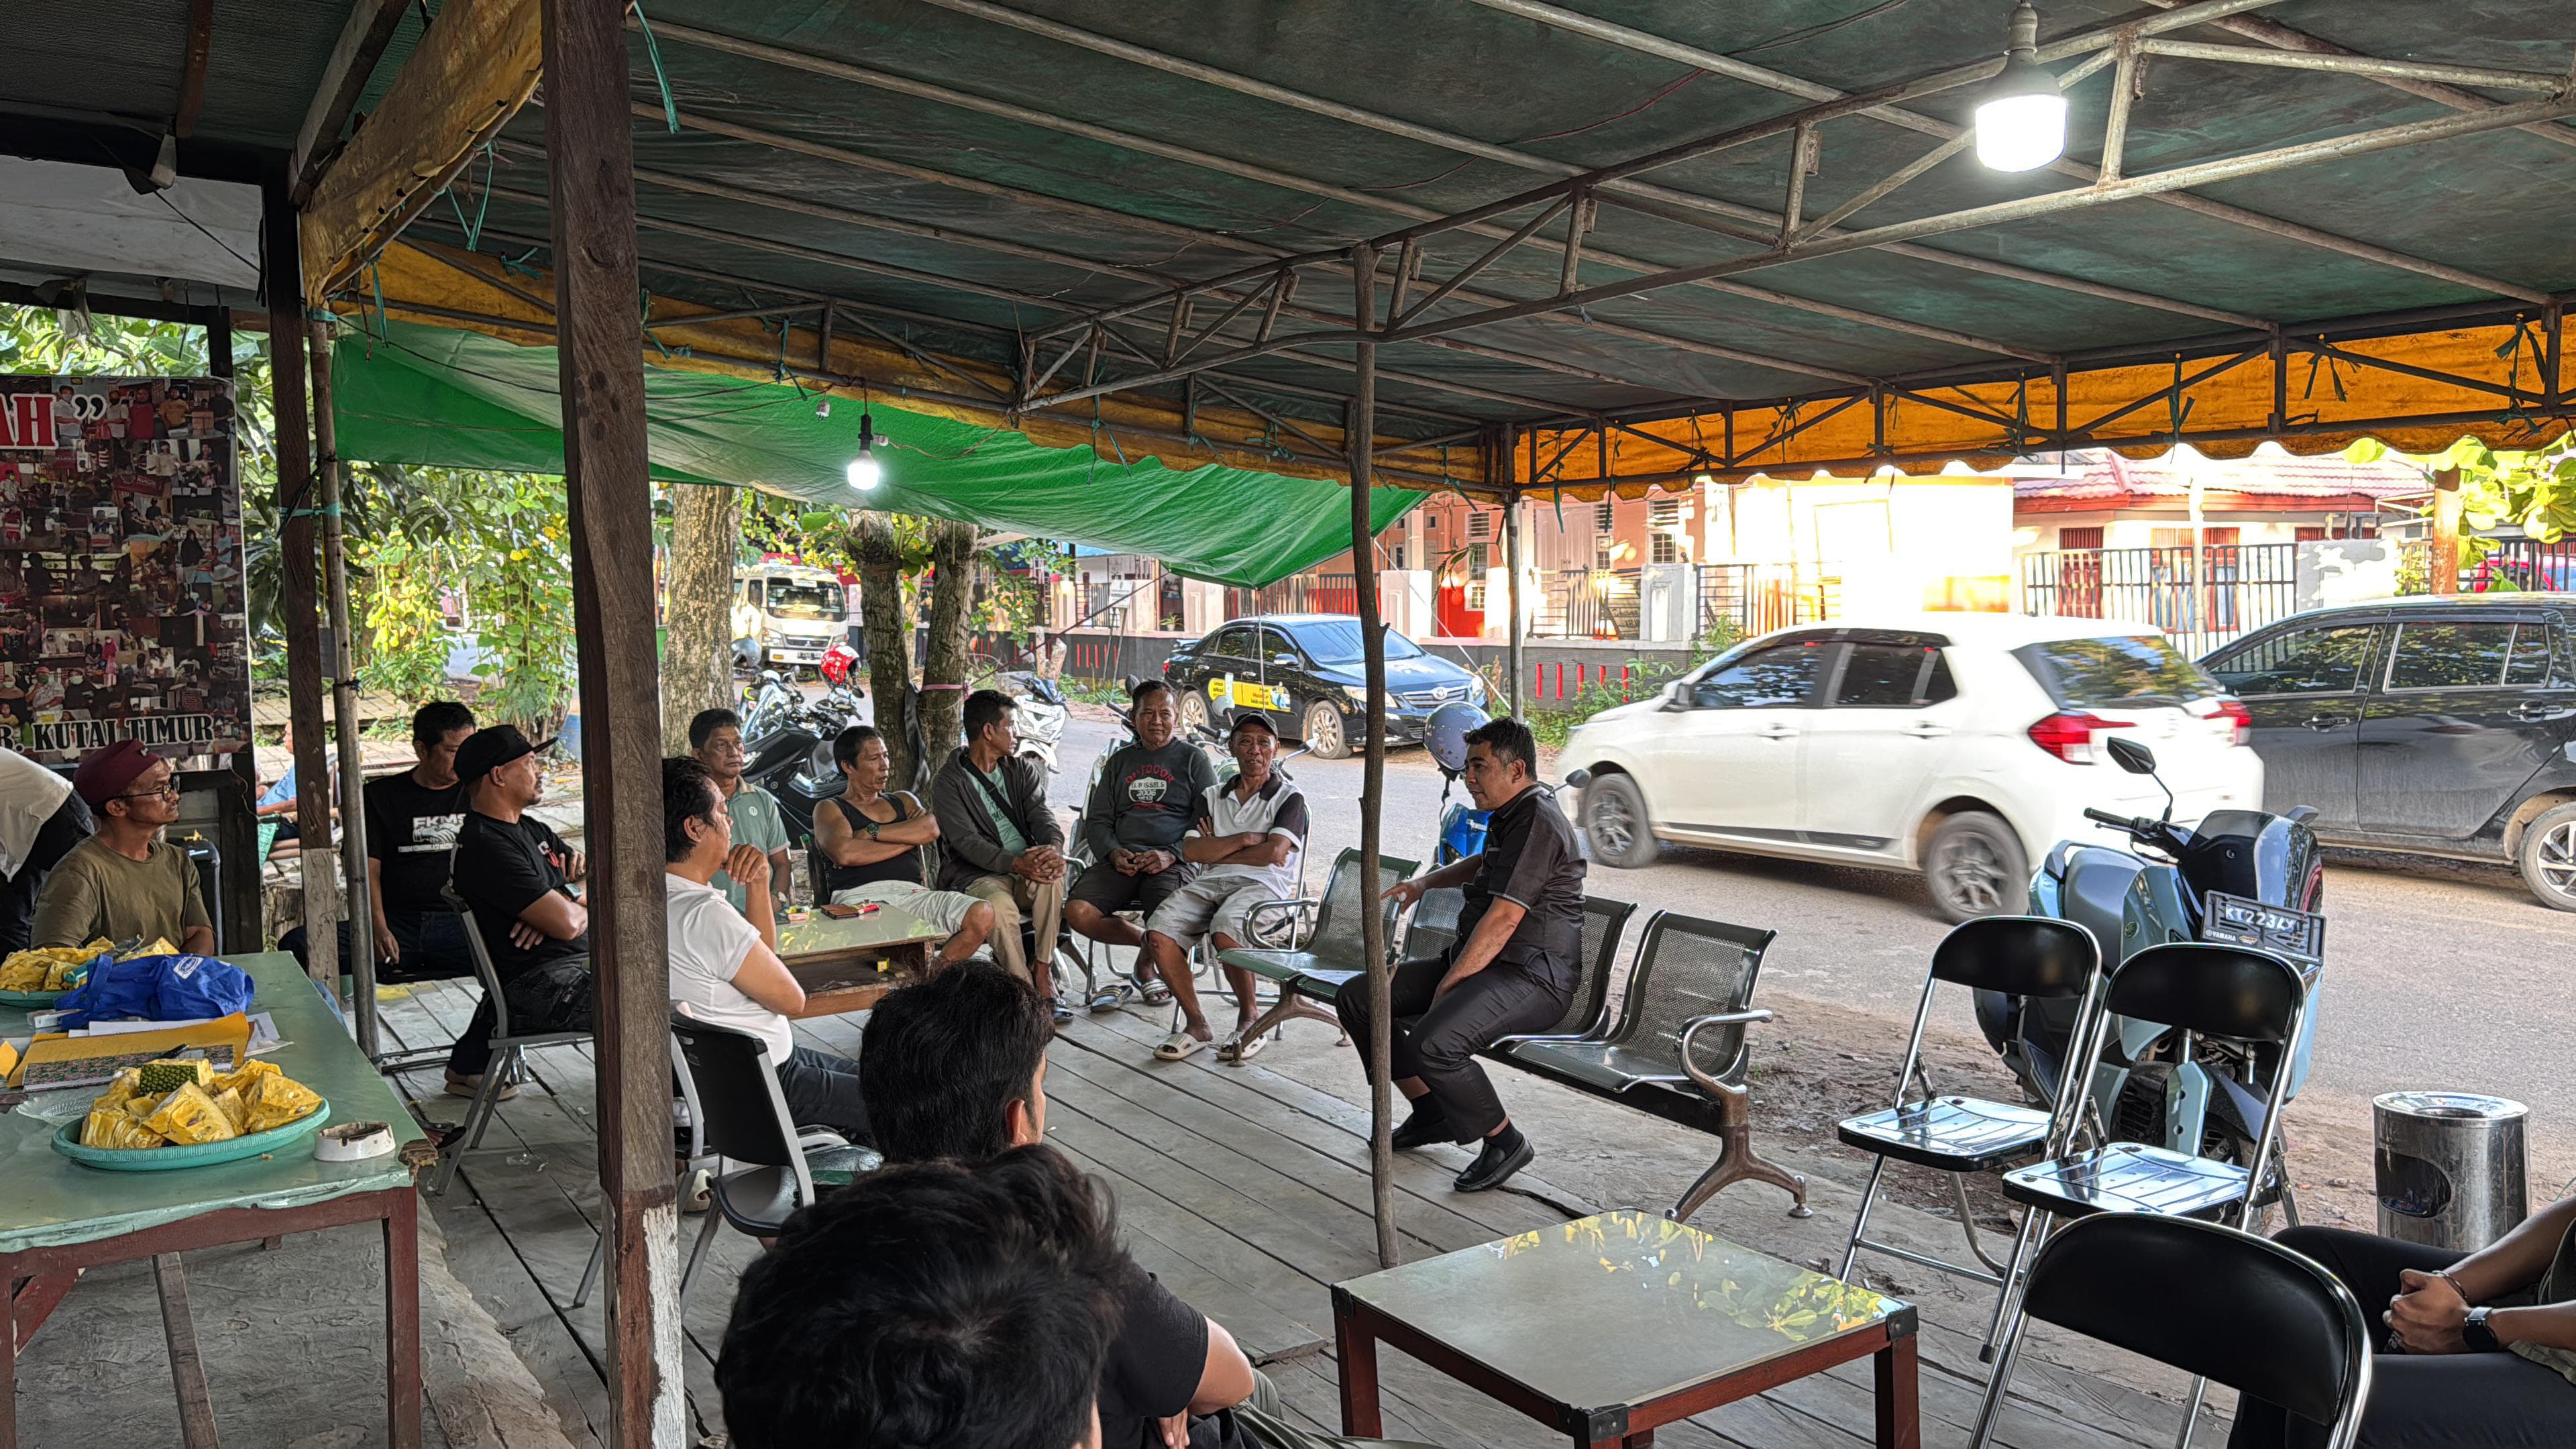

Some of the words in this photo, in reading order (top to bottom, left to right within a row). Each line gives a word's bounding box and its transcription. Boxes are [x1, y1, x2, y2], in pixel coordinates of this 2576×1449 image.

[34, 720, 117, 751] KUTAI
[125, 715, 214, 744] TIMUR
[2212, 931, 2237, 942] YAMAHA
